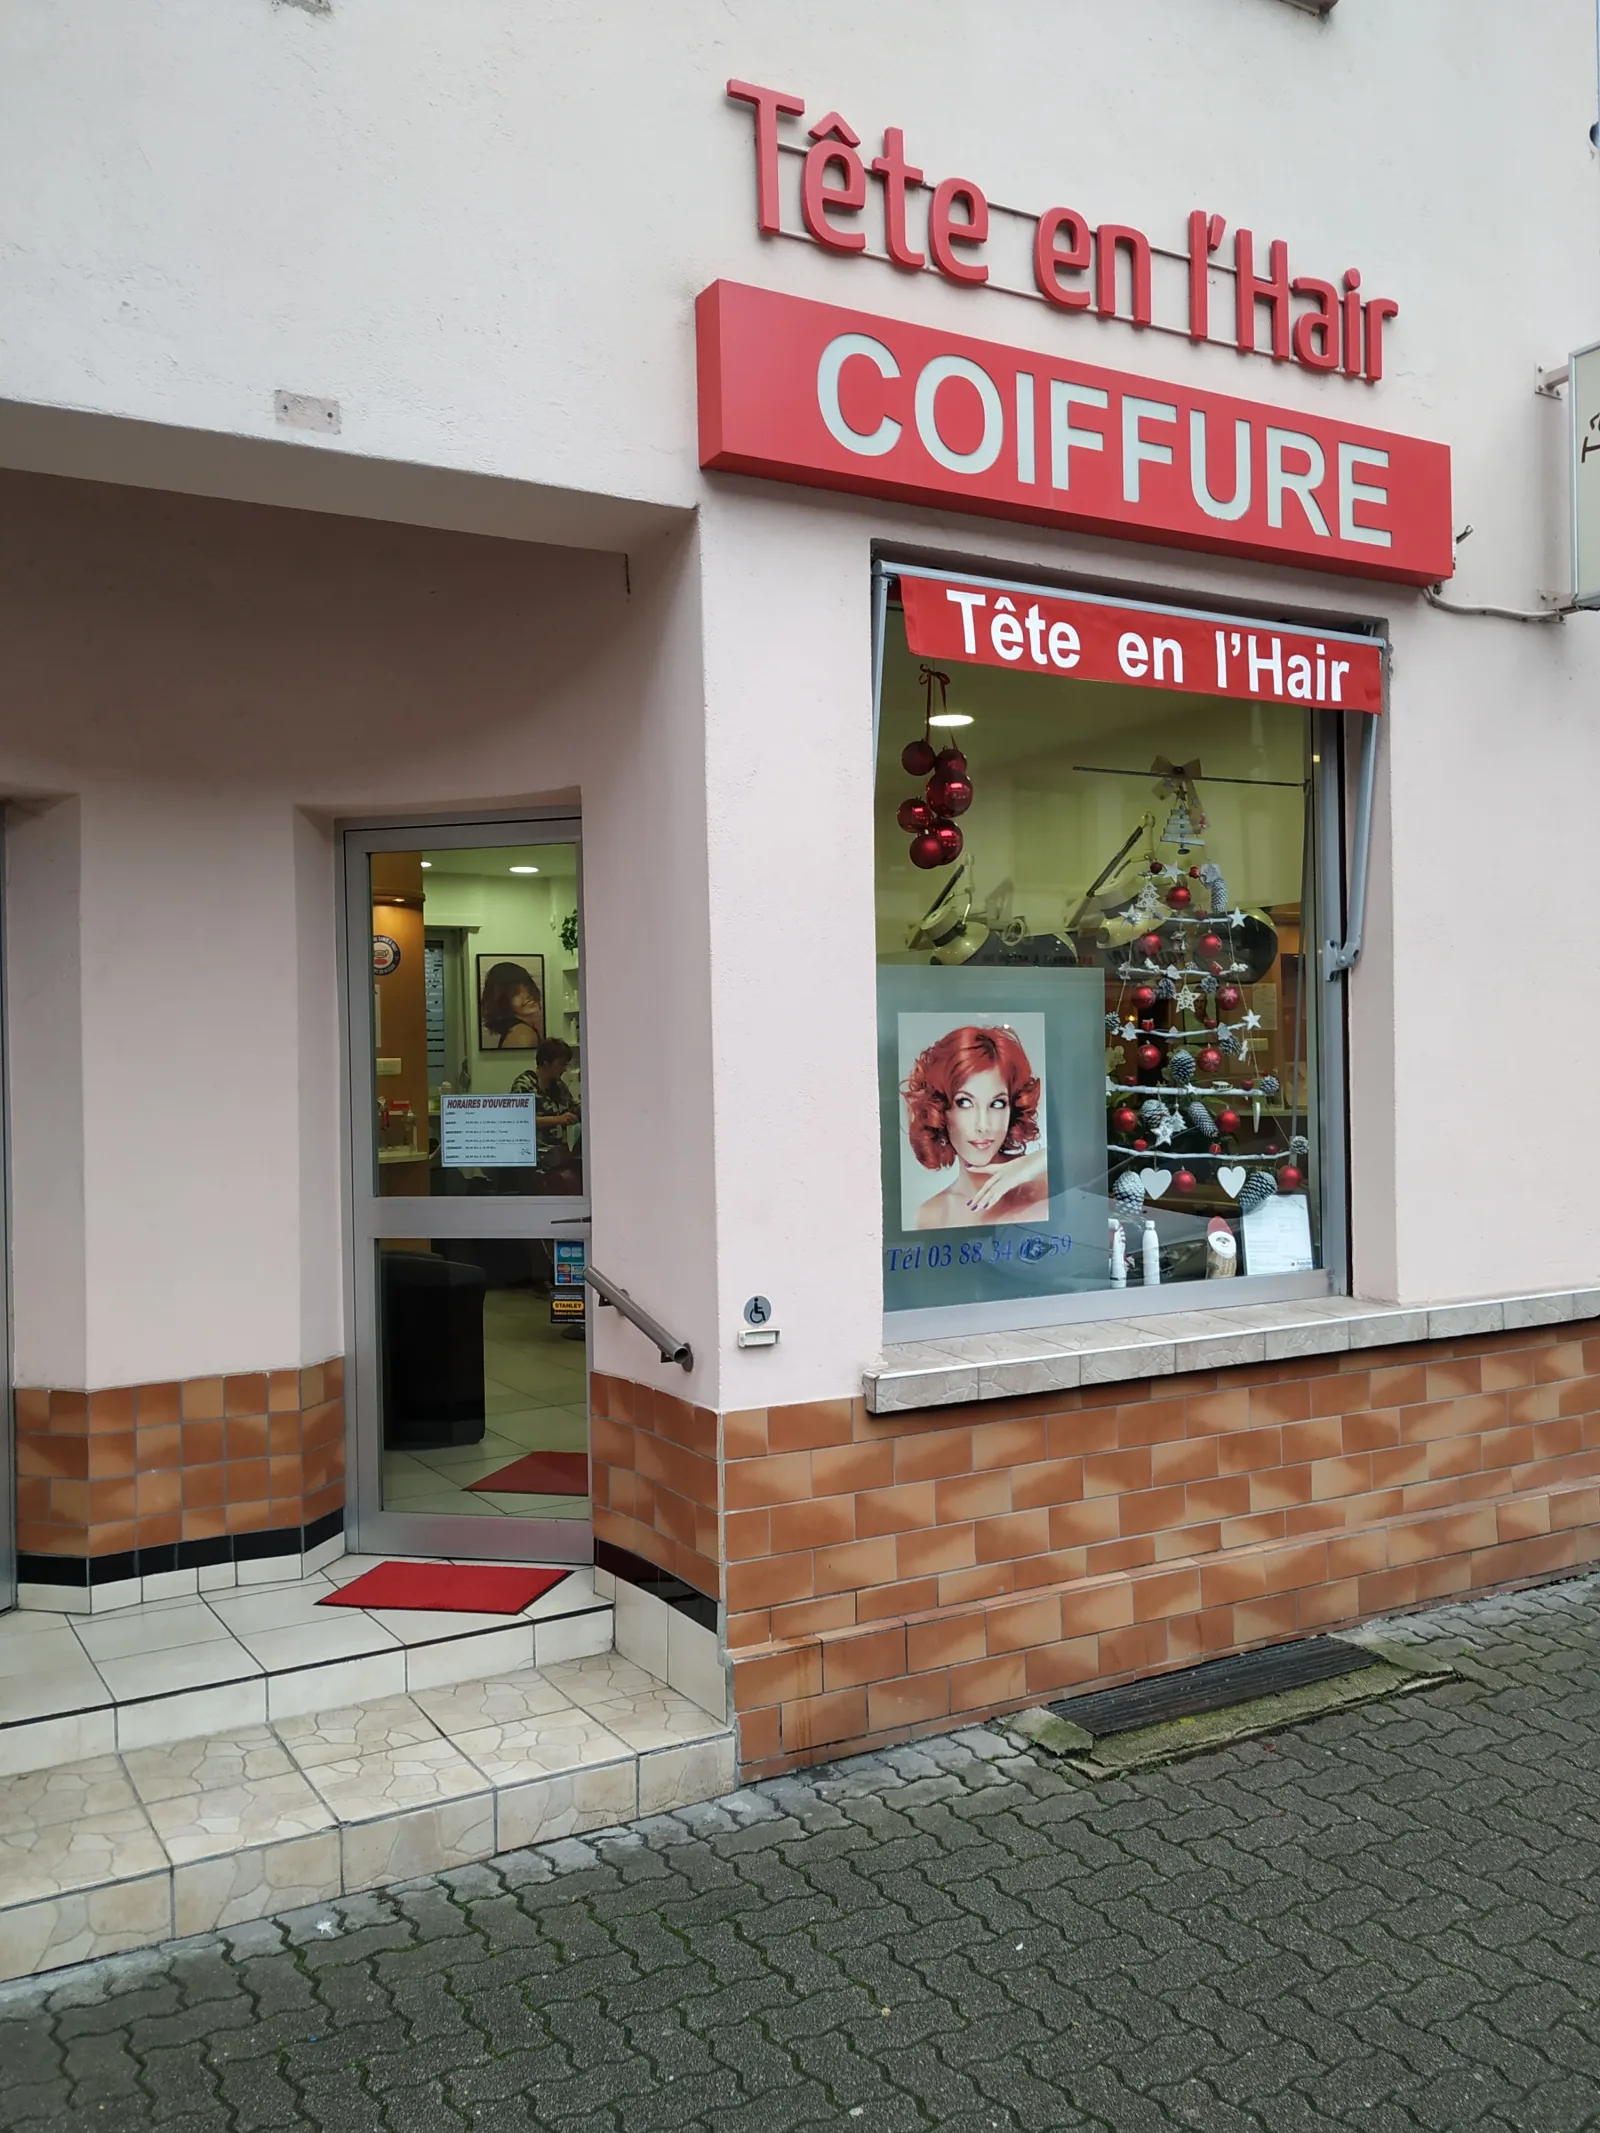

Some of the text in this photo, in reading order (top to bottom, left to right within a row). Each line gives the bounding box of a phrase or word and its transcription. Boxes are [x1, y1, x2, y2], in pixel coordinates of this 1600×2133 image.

[726, 78, 1398, 383] Tête en l'Hair
[816, 331, 1393, 548] COIFFURE
[946, 590, 1349, 703] Tête en l'Hair
[447, 1098, 530, 1109] HORAIRES D'OUVERTURE
[886, 1246, 921, 1271] Tél
[928, 1244, 952, 1267] 03
[959, 1241, 983, 1264] 88
[989, 1238, 1013, 1263] 34
[1050, 1233, 1073, 1257] 59
